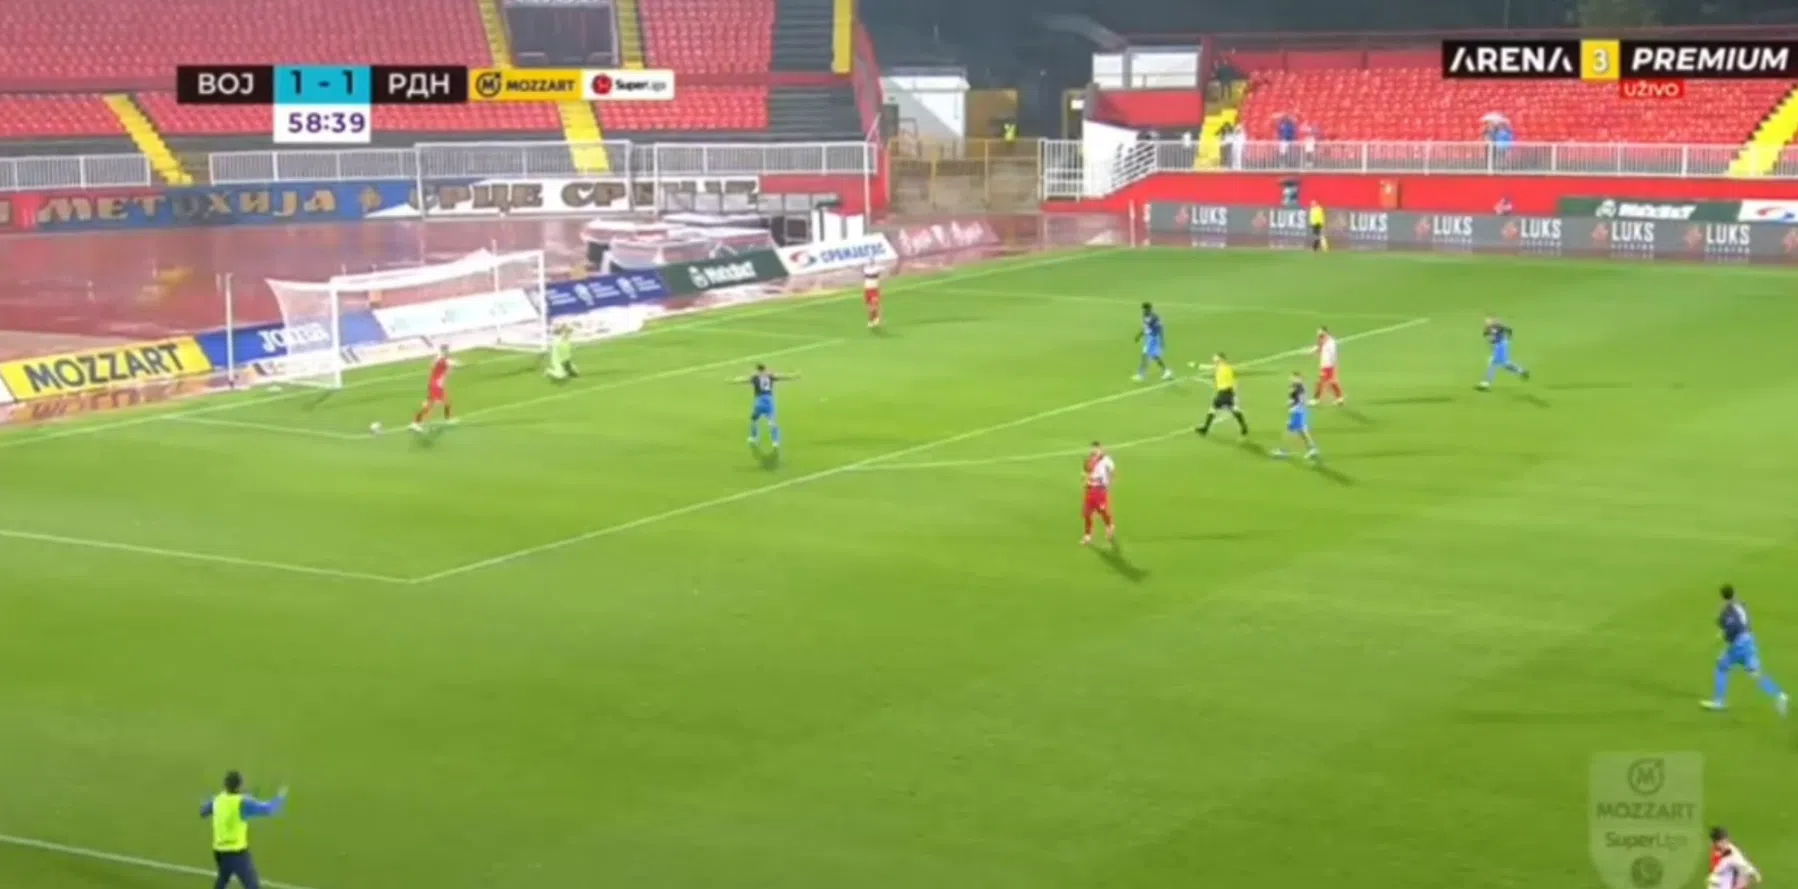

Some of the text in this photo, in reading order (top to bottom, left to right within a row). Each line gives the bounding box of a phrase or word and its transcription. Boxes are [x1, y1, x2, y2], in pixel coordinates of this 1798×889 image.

[1192, 205, 1228, 225] LUKS
[1269, 208, 1307, 229] LUKS
[1348, 212, 1389, 232] LUKS
[1432, 215, 1473, 235] LUKS
[1519, 218, 1563, 239] LUKS
[1611, 221, 1655, 242] LUKS
[1705, 224, 1751, 245] LUKS
[22, 344, 184, 393] MOZZART
